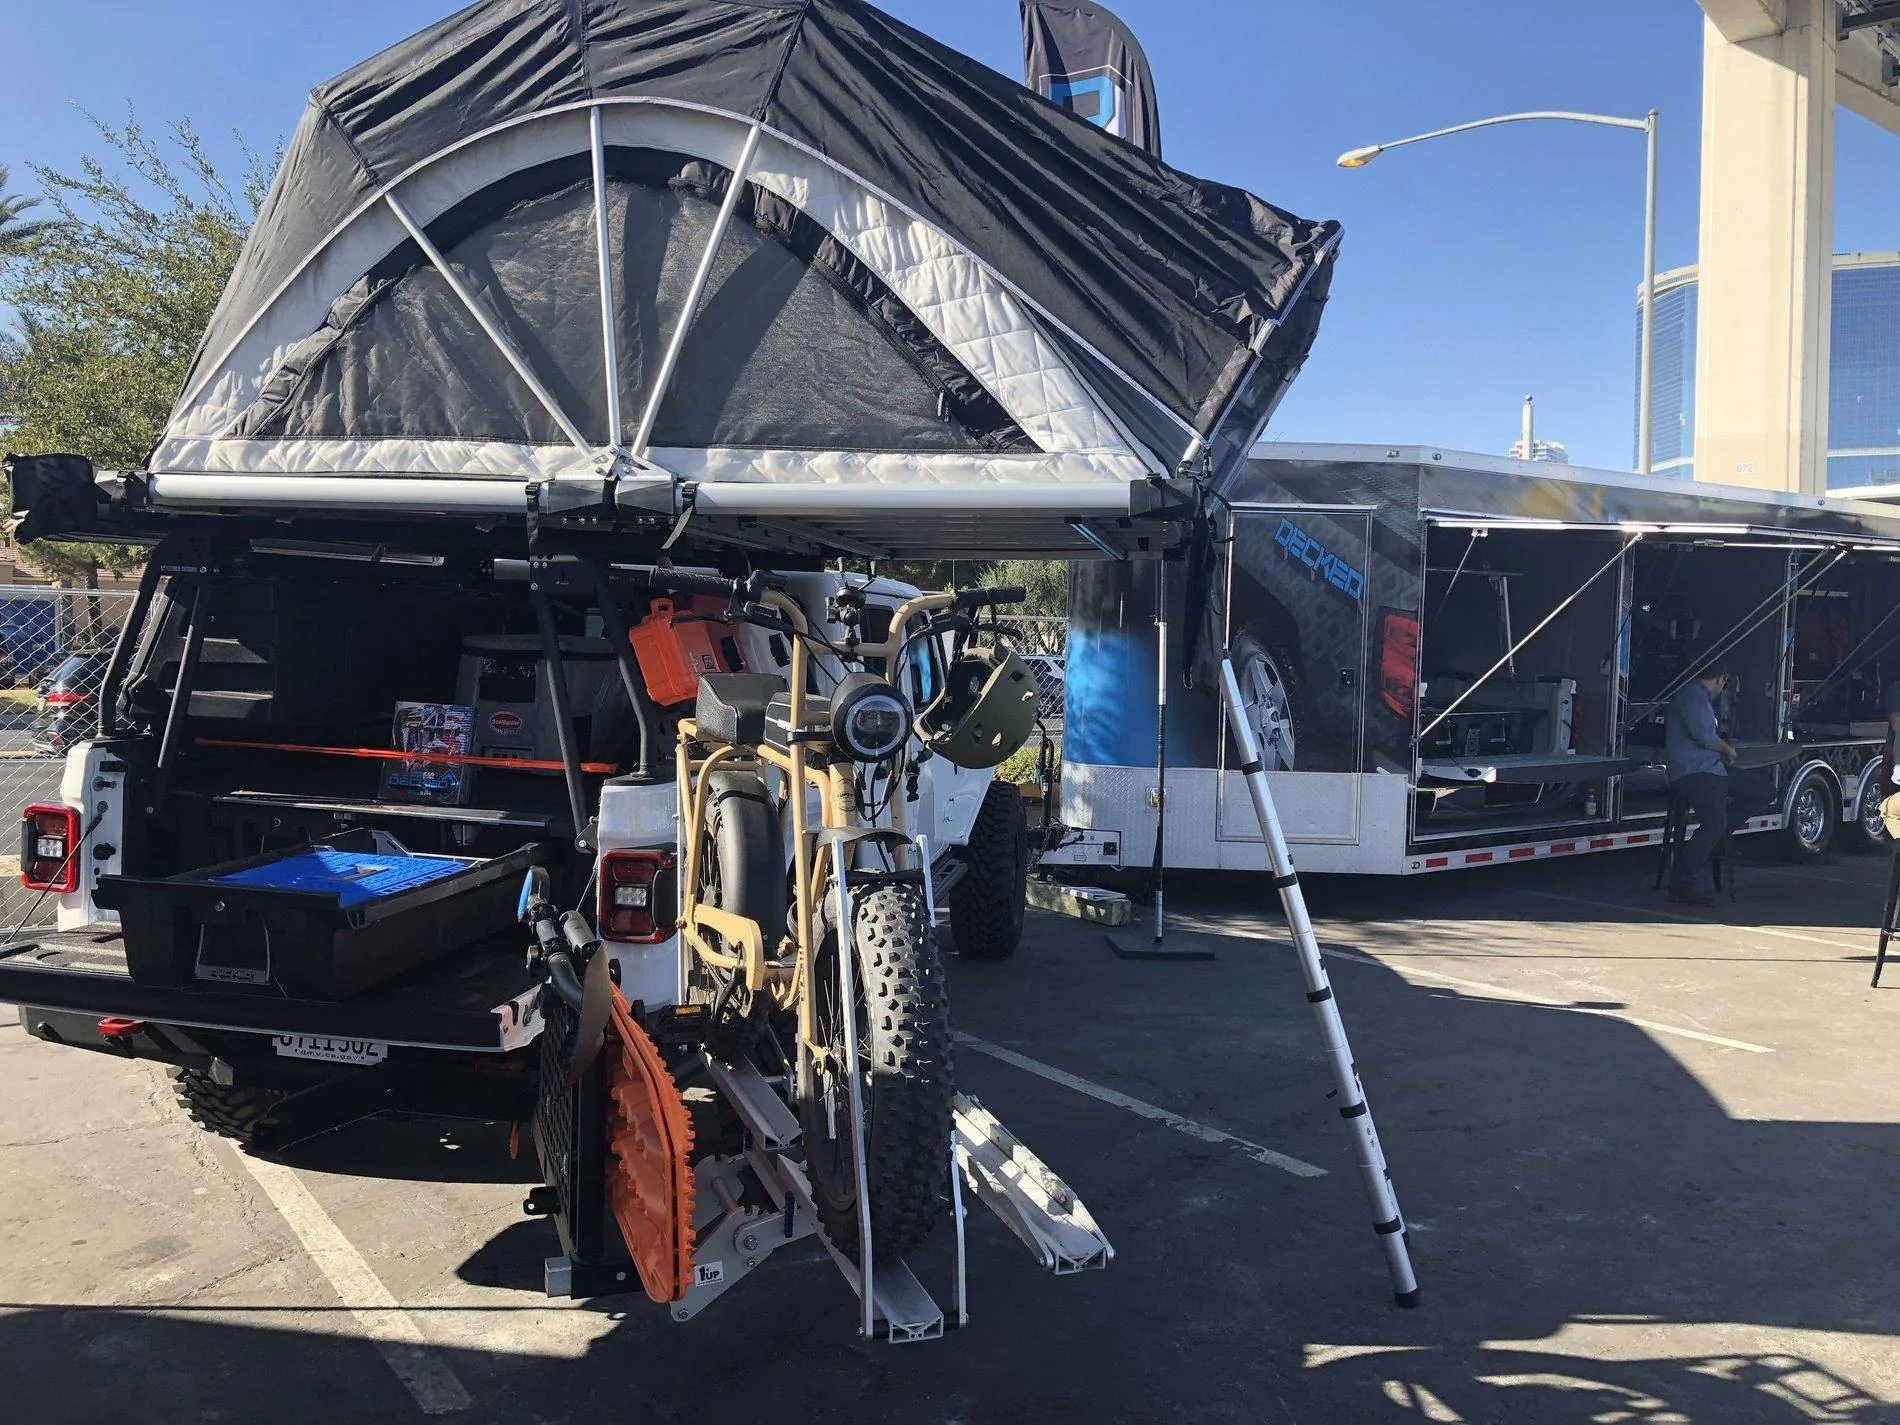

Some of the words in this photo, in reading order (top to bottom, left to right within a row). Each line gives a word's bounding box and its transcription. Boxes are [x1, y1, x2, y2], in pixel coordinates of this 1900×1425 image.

[1736, 463, 1753, 473] 072
[1274, 515, 1364, 601] DECKED
[300, 1050, 359, 1061] dmv.ca.gov
